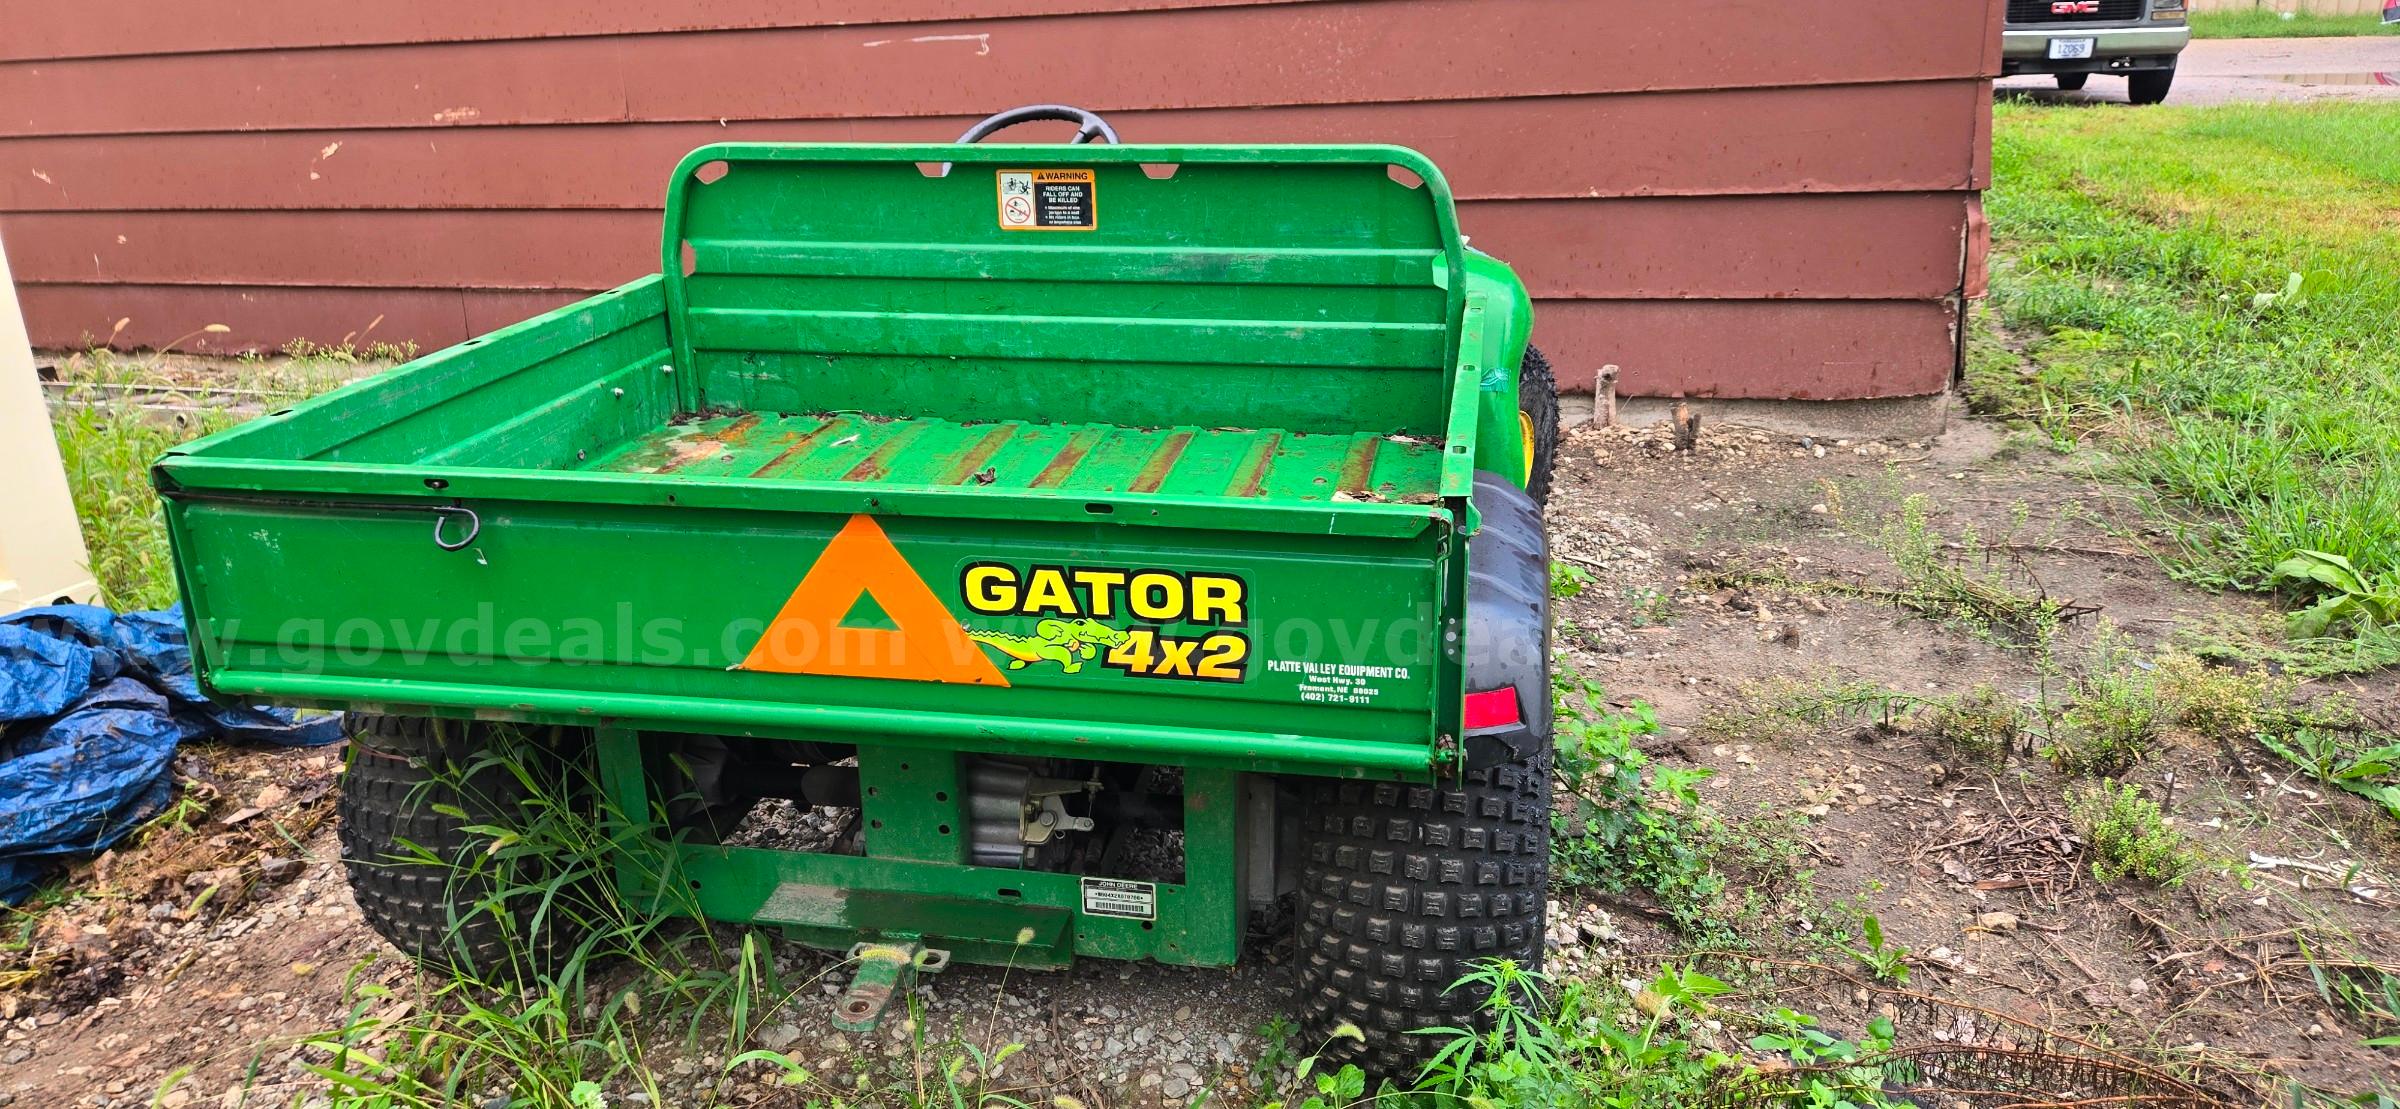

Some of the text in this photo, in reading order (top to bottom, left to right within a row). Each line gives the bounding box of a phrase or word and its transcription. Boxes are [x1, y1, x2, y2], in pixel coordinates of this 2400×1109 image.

[2051, 1, 2099, 13] GMC
[1045, 172, 1087, 180] WARNING
[966, 566, 1242, 623] GATOR
[1108, 631, 1246, 678] 4x2
[1267, 659, 1410, 680] PLATTE VALLEY EQUIPMENT CO.
[1308, 675, 1331, 684] West
[1333, 676, 1353, 686] Hwy.
[1301, 692, 1370, 704] (402) 721-9111
